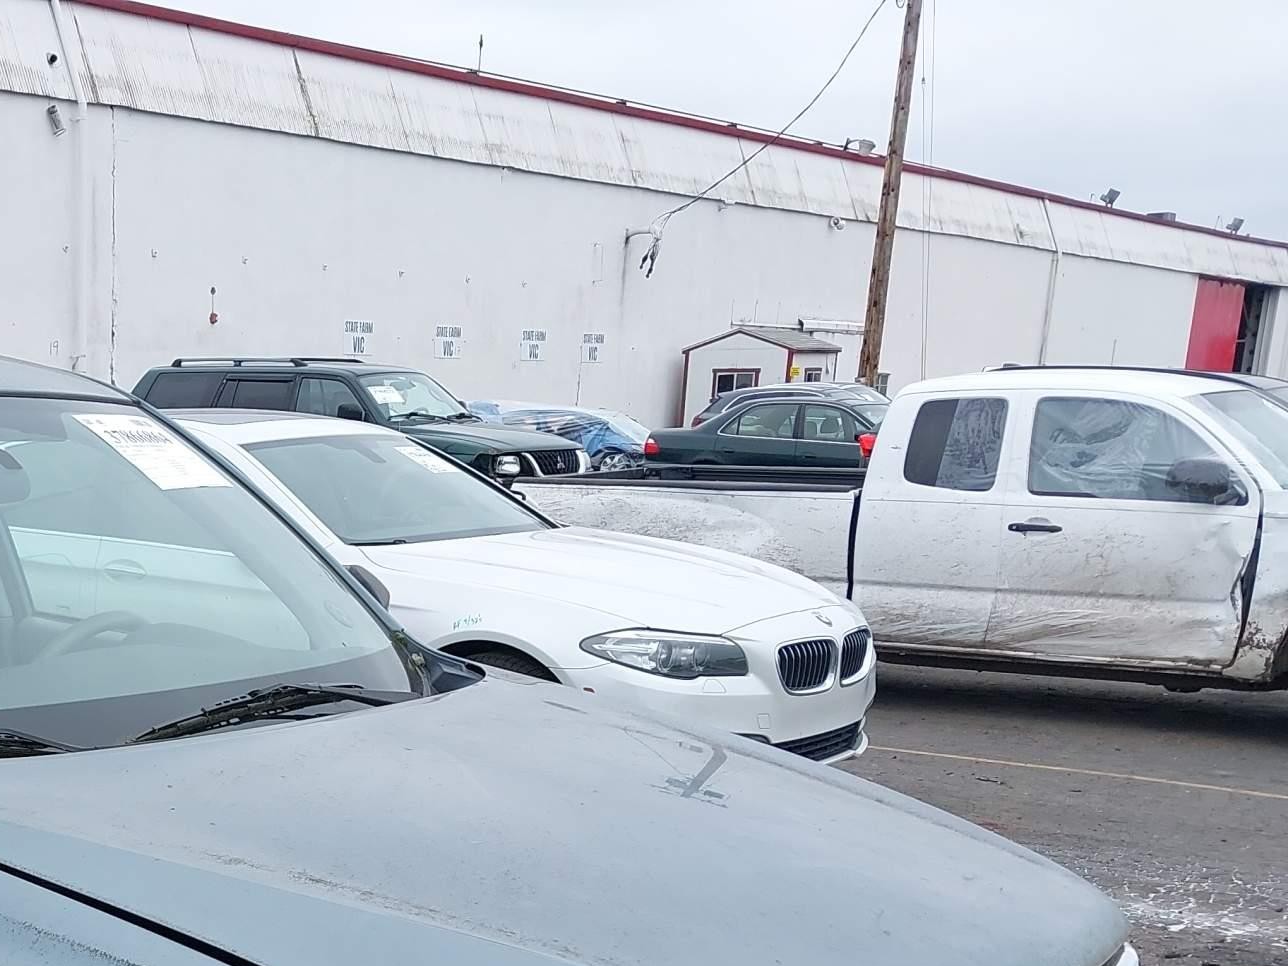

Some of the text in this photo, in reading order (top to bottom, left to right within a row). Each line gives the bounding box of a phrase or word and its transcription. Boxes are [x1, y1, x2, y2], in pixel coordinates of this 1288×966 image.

[345, 321, 373, 334] STATE FARM
[352, 336, 365, 353] VIC
[443, 341, 454, 357] VIC
